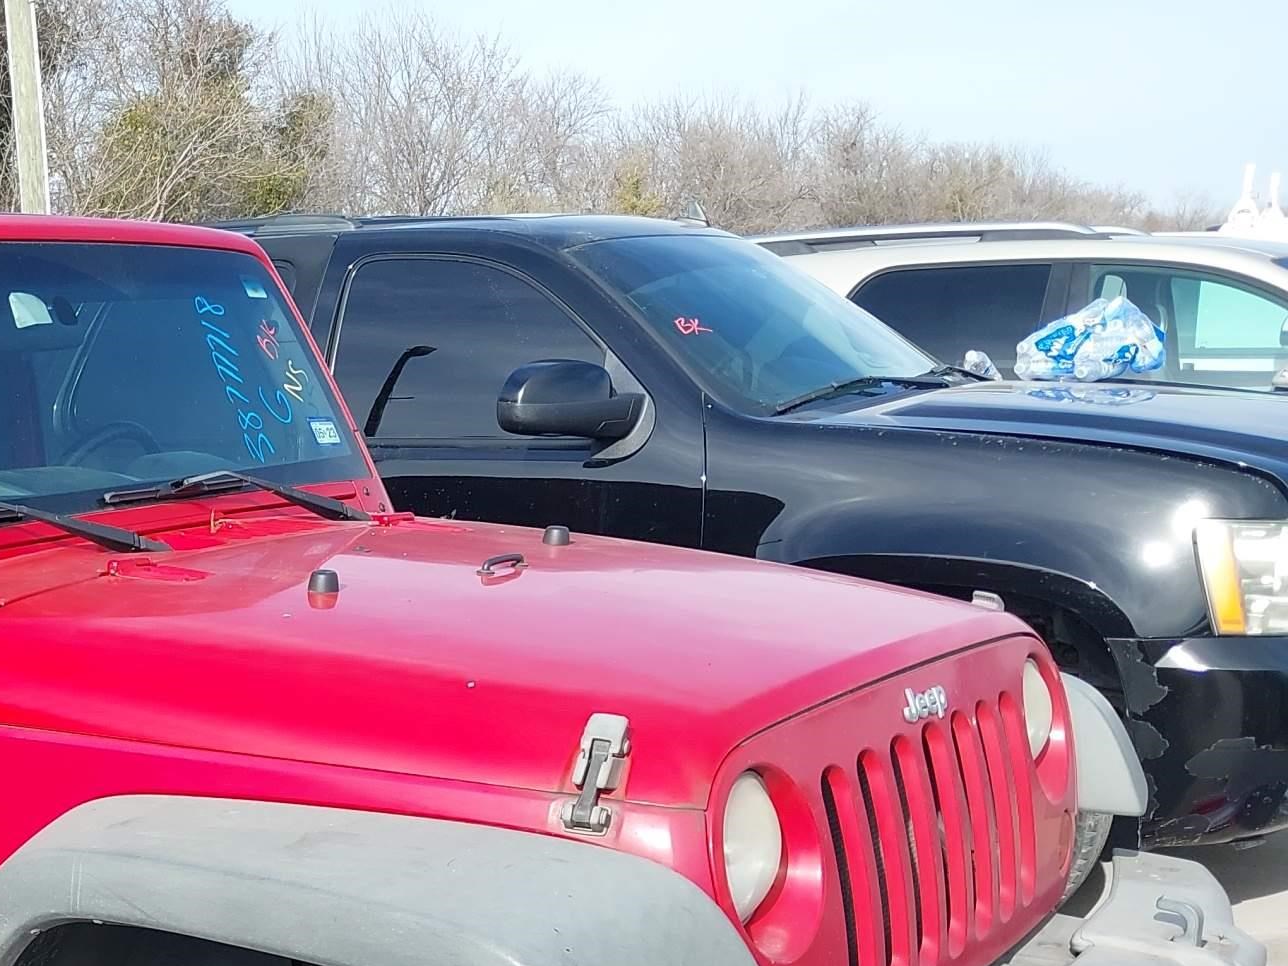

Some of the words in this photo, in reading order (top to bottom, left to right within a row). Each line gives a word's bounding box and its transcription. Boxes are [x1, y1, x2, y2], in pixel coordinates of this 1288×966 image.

[674, 317, 713, 335] BK
[283, 360, 309, 402] NS
[903, 685, 948, 722] Jeep
